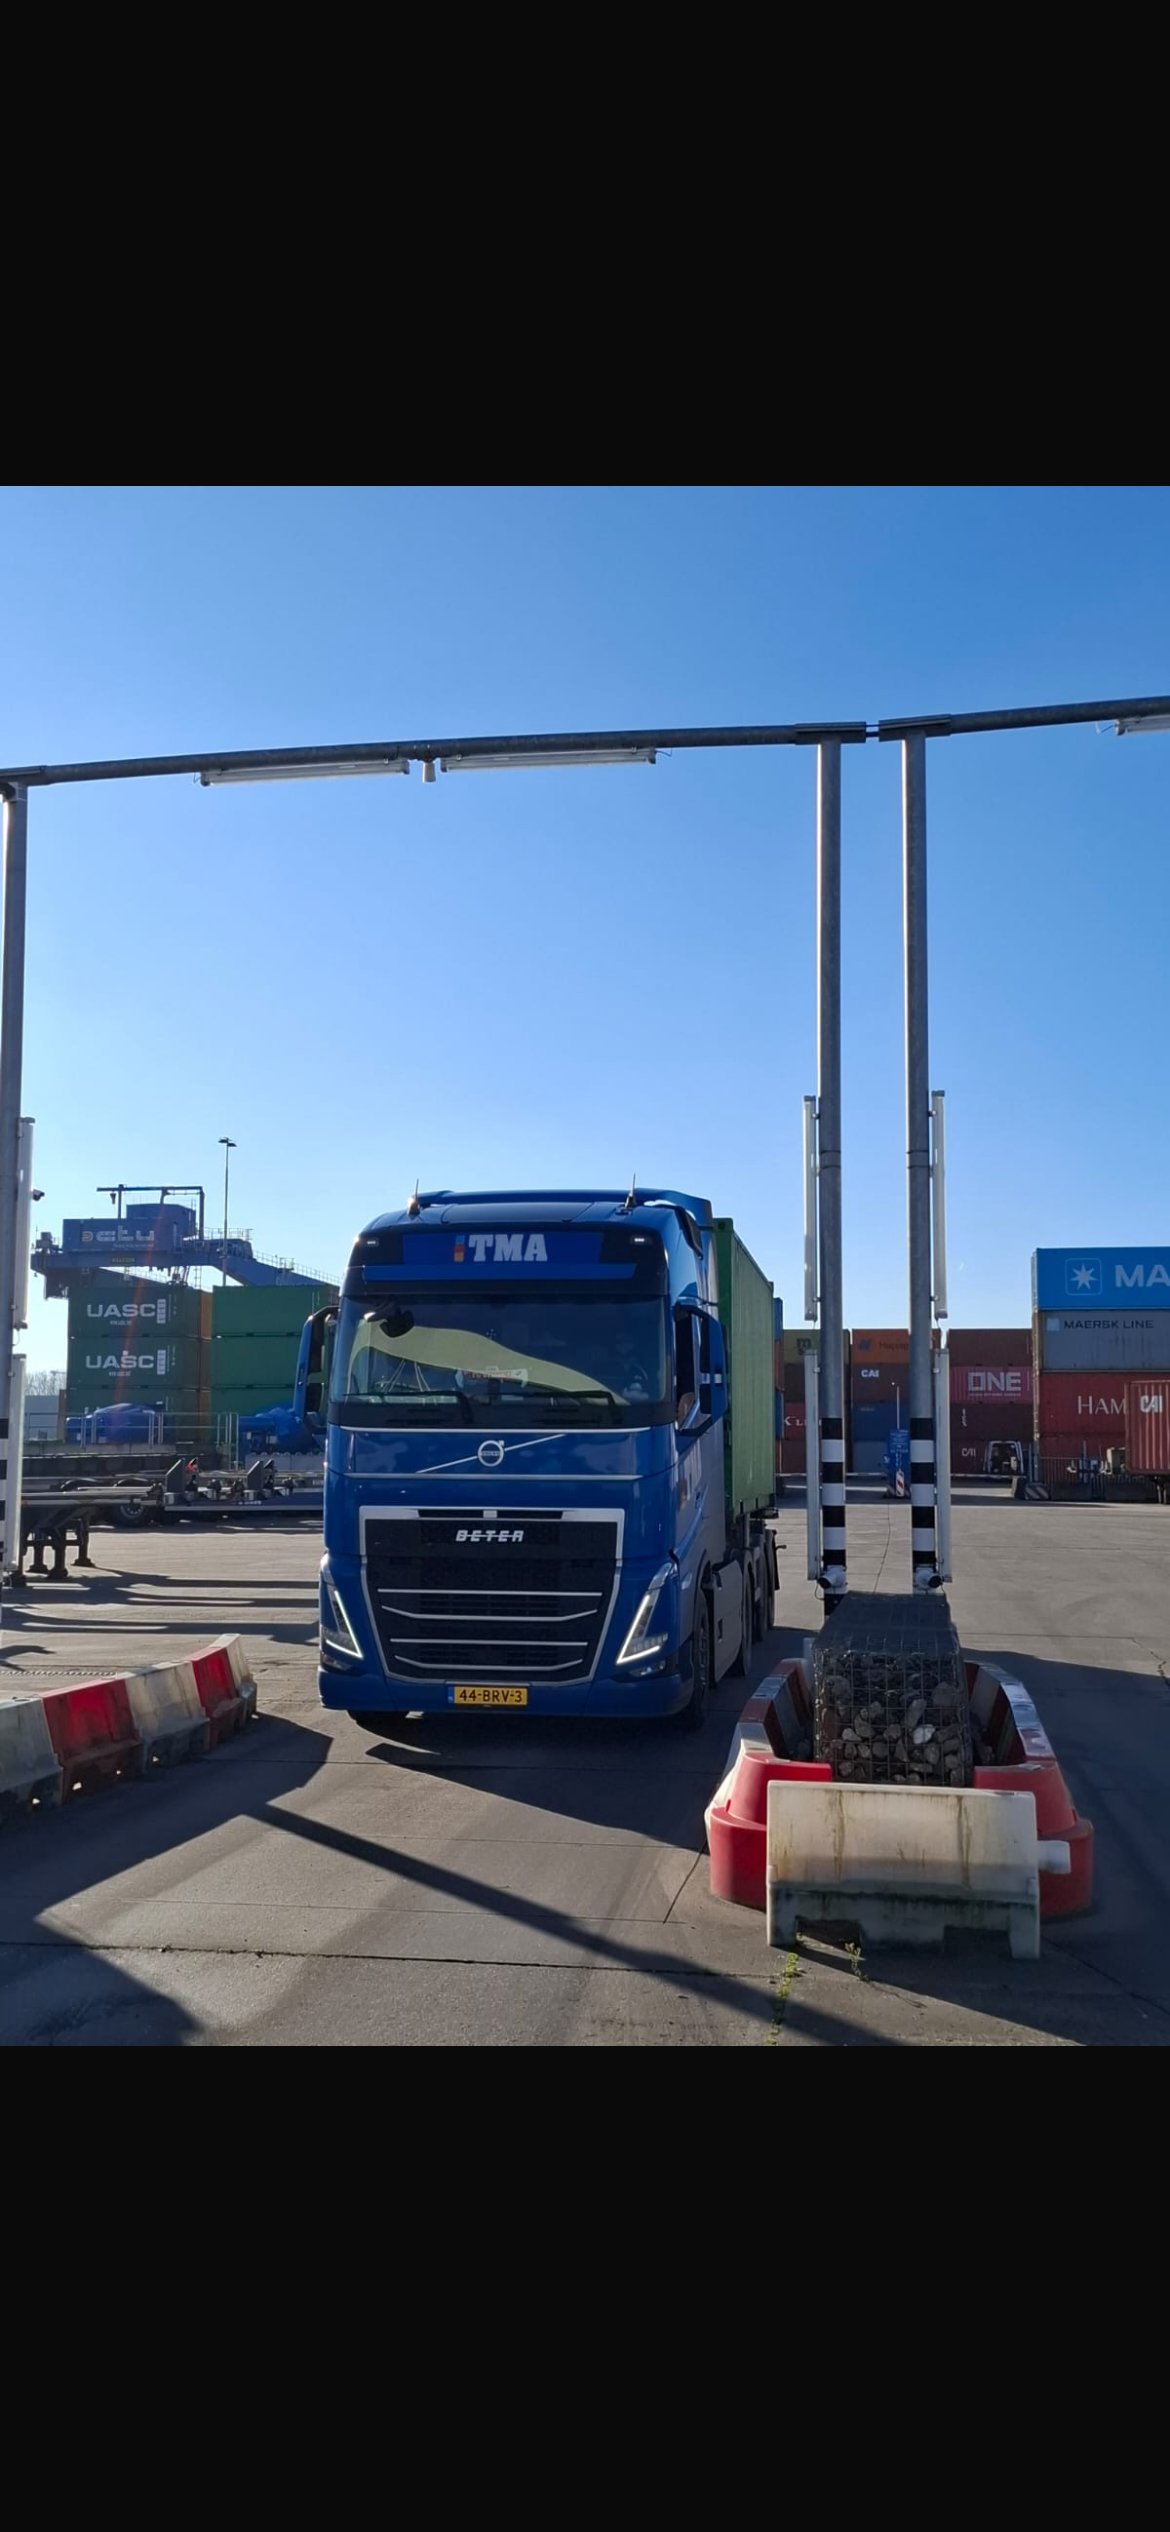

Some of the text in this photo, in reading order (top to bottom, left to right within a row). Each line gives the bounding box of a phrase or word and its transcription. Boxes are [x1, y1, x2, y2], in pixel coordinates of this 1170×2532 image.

[468, 1234, 548, 1262] TMA
[87, 1304, 156, 1318] UASC
[1064, 1320, 1154, 1329] MAERSK LINE
[85, 1355, 154, 1369] UASC
[861, 1369, 880, 1378] CAI
[968, 1372, 1021, 1392] ONE
[1140, 1395, 1163, 1413] CAI
[455, 1530, 524, 1542] BETER
[459, 1689, 522, 1703] 44-BRV-3
